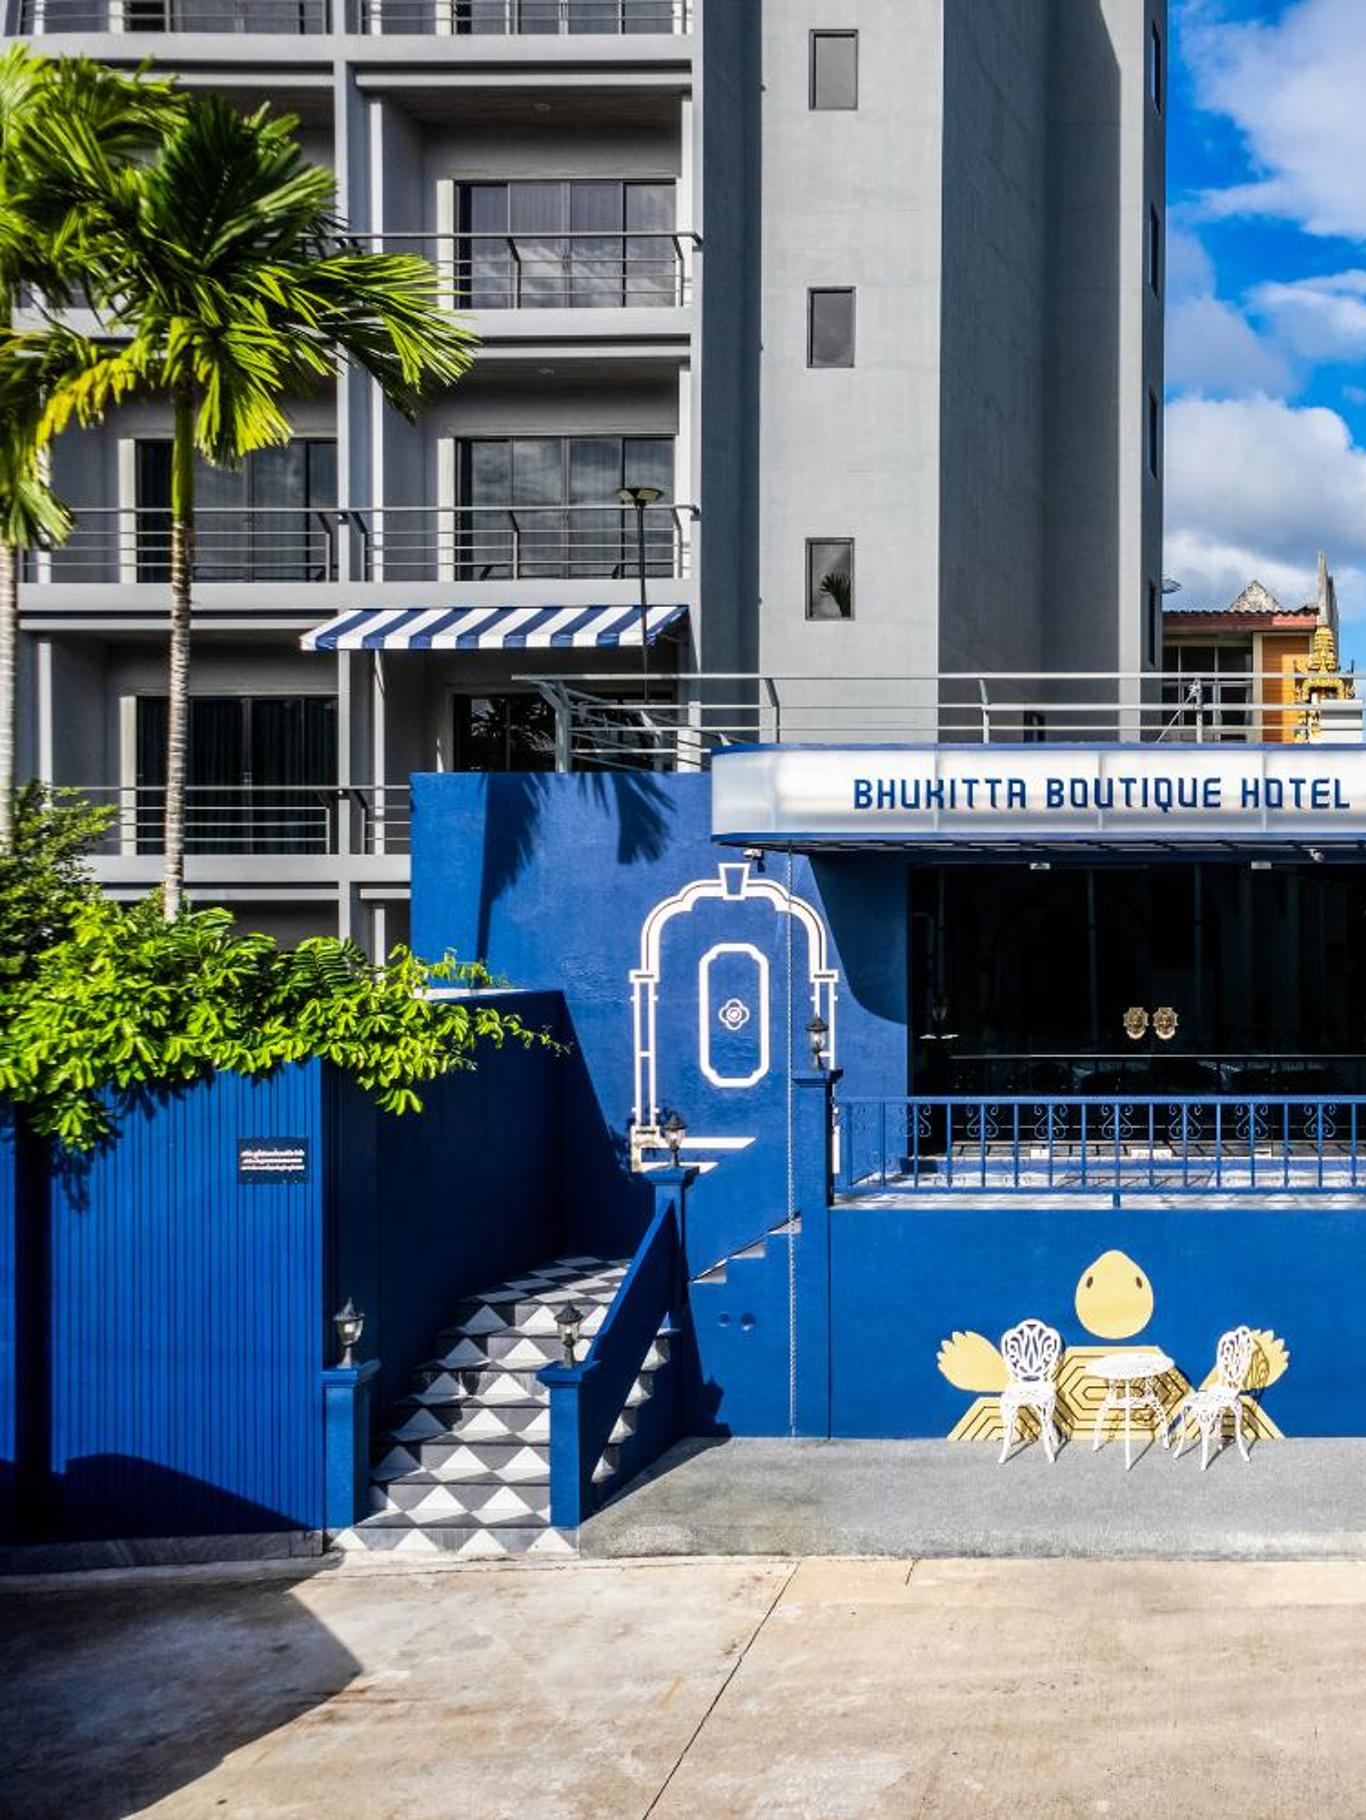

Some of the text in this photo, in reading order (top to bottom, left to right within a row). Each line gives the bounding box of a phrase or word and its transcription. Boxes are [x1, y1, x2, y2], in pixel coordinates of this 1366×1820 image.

[854, 778, 1351, 814] BHUKITTA BOUTIQUE HOTEL
